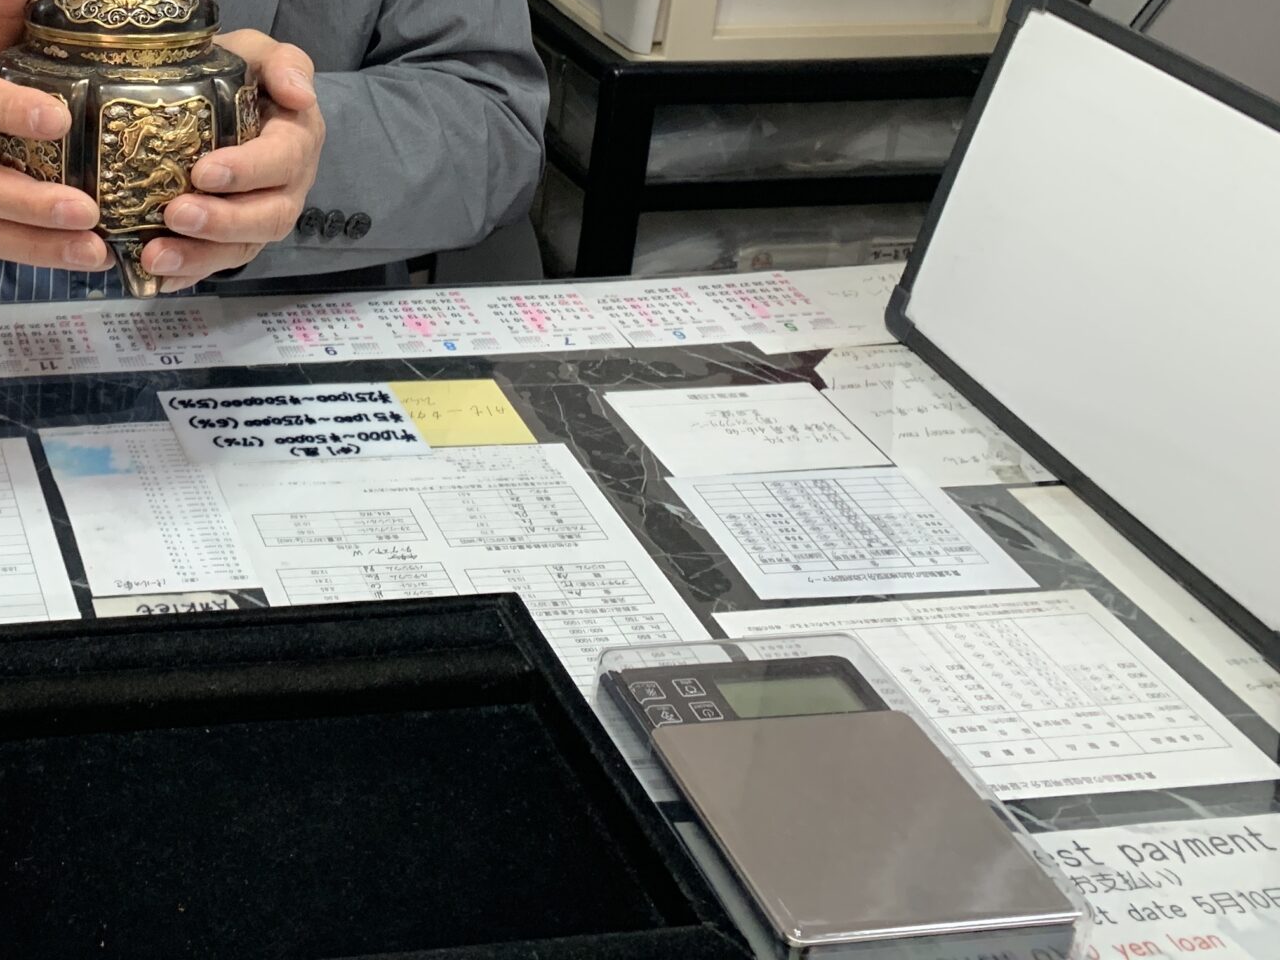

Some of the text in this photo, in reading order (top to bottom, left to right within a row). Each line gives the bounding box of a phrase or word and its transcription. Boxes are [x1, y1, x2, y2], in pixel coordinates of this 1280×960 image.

[784, 323, 798, 332] 5
[672, 331, 686, 340] 6
[564, 337, 576, 346] 7
[443, 342, 457, 351] 8
[324, 347, 337, 356] 9
[160, 355, 183, 365] 10
[39, 361, 58, 371] 11
[1117, 825, 1277, 867] payment
[1127, 902, 1187, 922] date
[1166, 934, 1226, 952] loan
